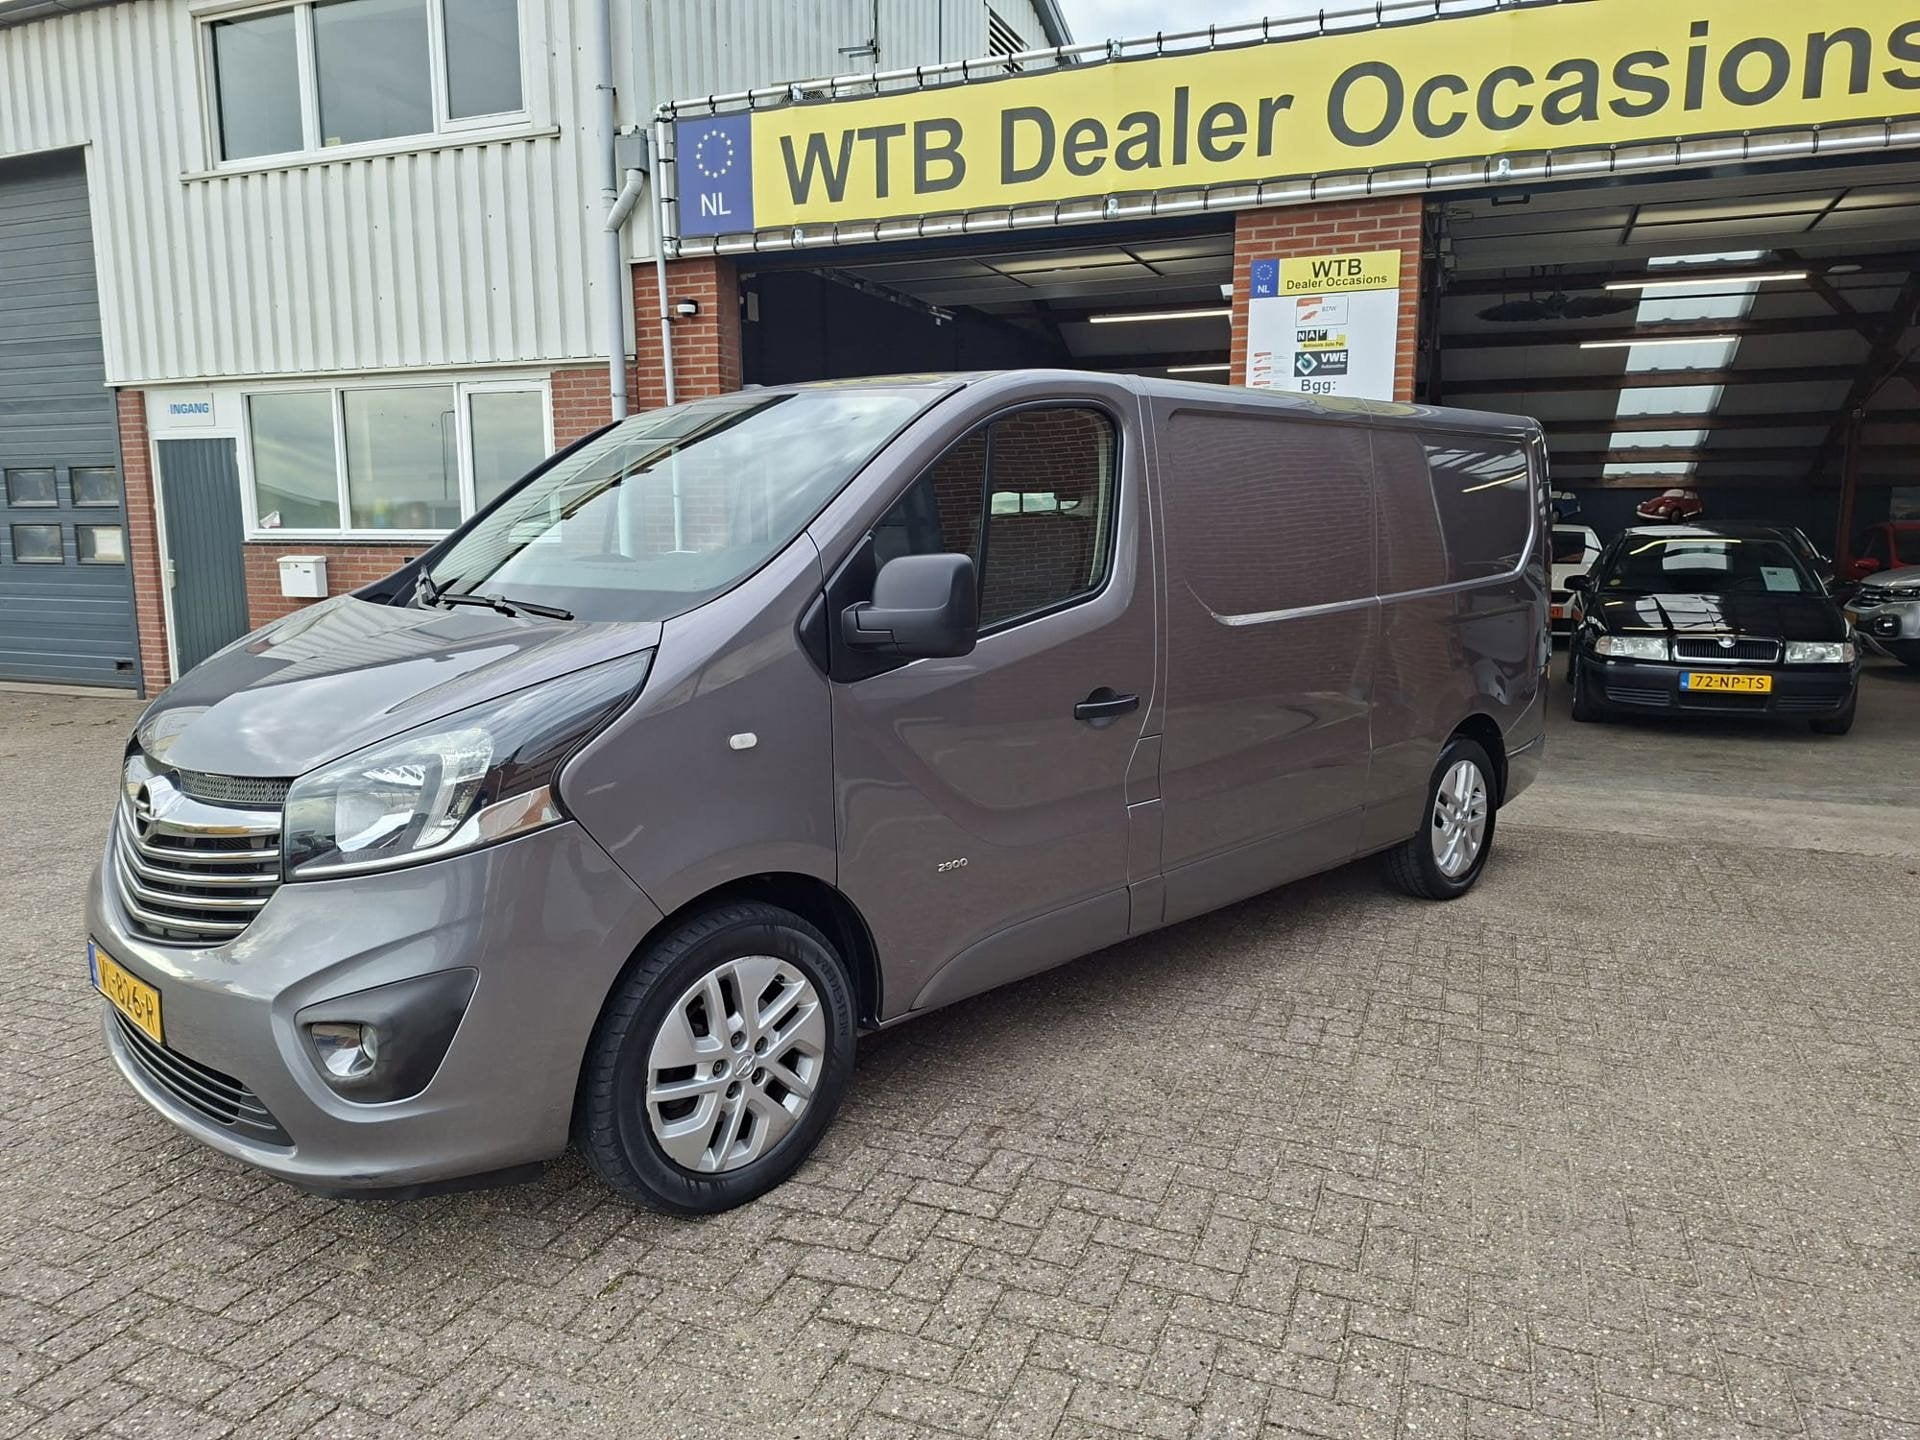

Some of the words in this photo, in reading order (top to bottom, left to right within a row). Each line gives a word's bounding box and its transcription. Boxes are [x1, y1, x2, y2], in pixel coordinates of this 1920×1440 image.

[779, 117, 967, 205] WTB
[1001, 86, 1294, 185] Dealer
[701, 193, 731, 217] NL
[1312, 258, 1362, 278] WTB
[1257, 285, 1270, 294] NL
[1287, 279, 1323, 290] Dealer
[1326, 274, 1388, 287] Occasions
[1298, 329, 1326, 341] NAP
[1320, 352, 1347, 362] VWE
[1301, 379, 1336, 394] Bgg:
[169, 403, 209, 415] INGANG
[1695, 675, 1764, 690] 72-NP-TS
[938, 857, 968, 872] 2900
